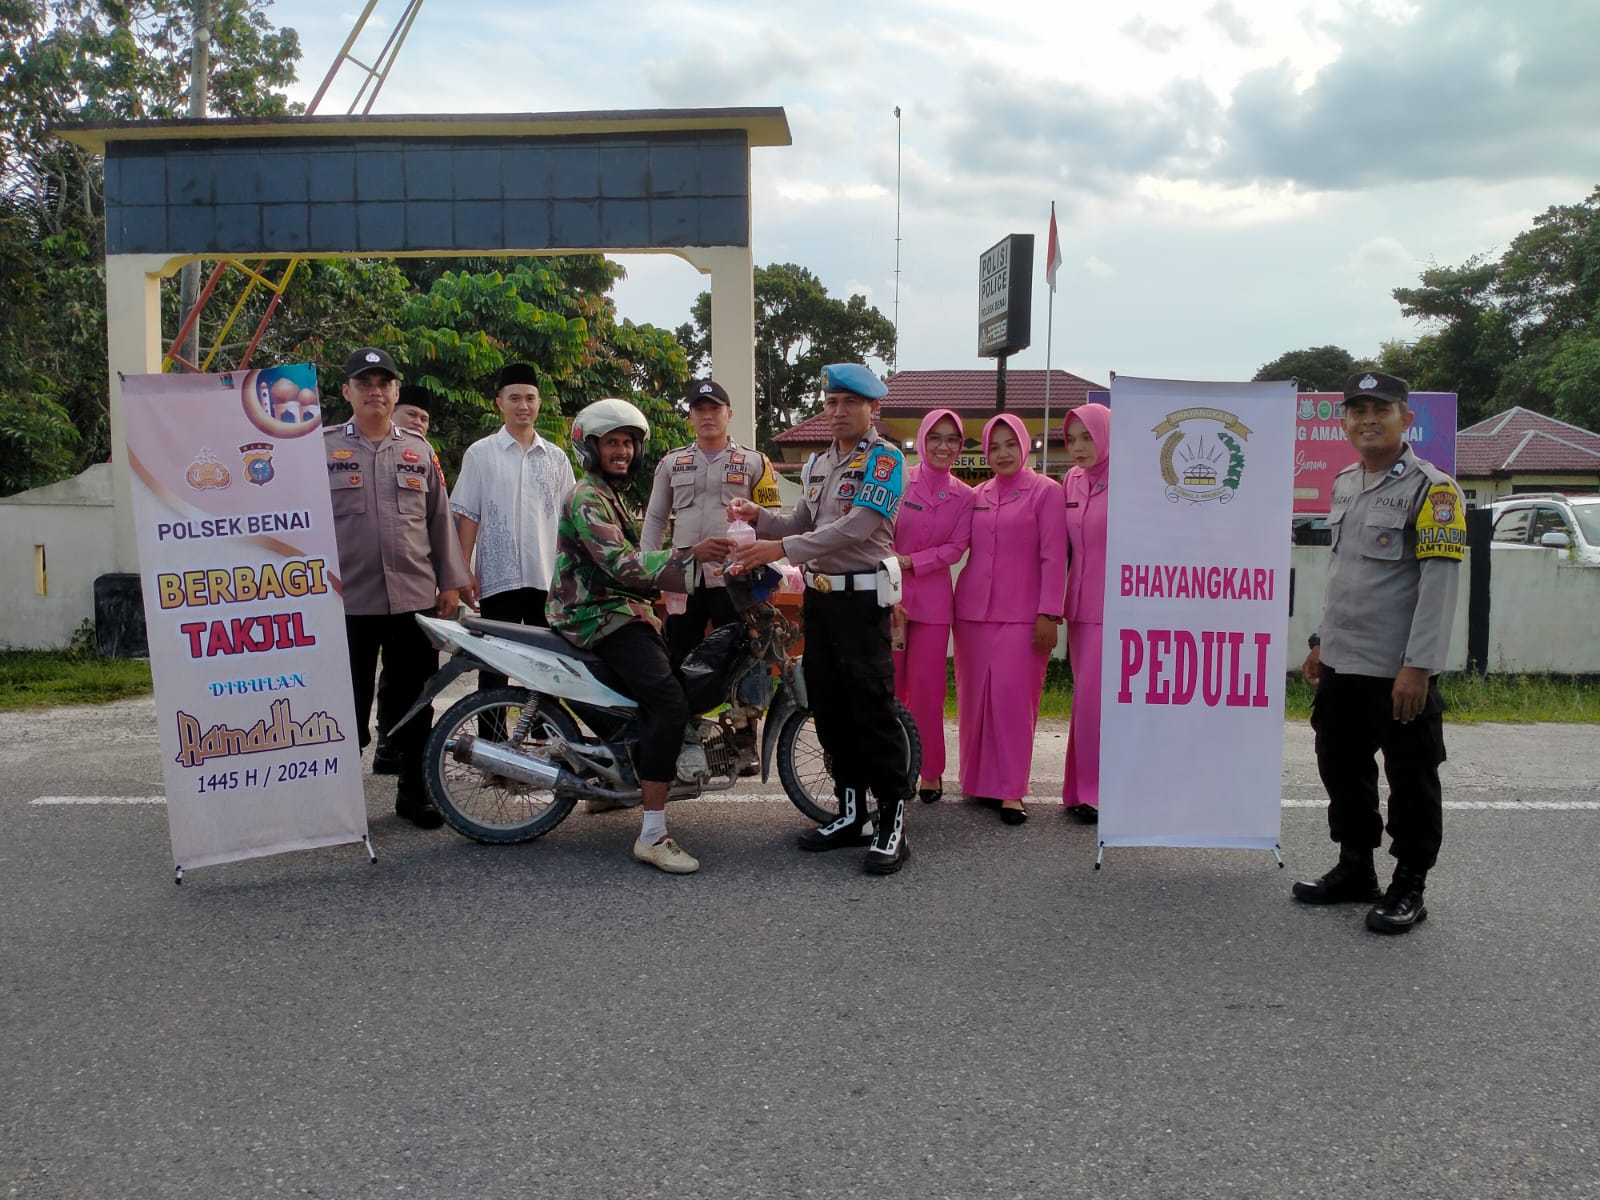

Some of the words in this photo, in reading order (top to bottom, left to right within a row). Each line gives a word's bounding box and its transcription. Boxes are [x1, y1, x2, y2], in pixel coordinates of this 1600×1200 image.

[982, 245, 1008, 277] POLISI
[981, 270, 1007, 300] POLICE
[397, 464, 426, 474] POLRI
[724, 464, 747, 473] POLRI
[952, 456, 976, 466] SEK
[1375, 497, 1409, 509] POLRI
[158, 517, 243, 541] POLSEK
[247, 511, 311, 535] BENAI
[1418, 527, 1466, 545] HABI
[157, 558, 328, 609] BERBAGI
[1120, 563, 1275, 601] BHAYANGKARI
[180, 612, 316, 659] TAKJIL
[1117, 628, 1272, 708] PEDULI
[208, 673, 307, 697] DIBULAN
[175, 698, 346, 768] Ramadhan
[197, 771, 239, 793] 1445
[245, 768, 258, 787] H
[263, 766, 272, 788] /
[278, 760, 319, 783] 2024
[324, 757, 338, 775] M
